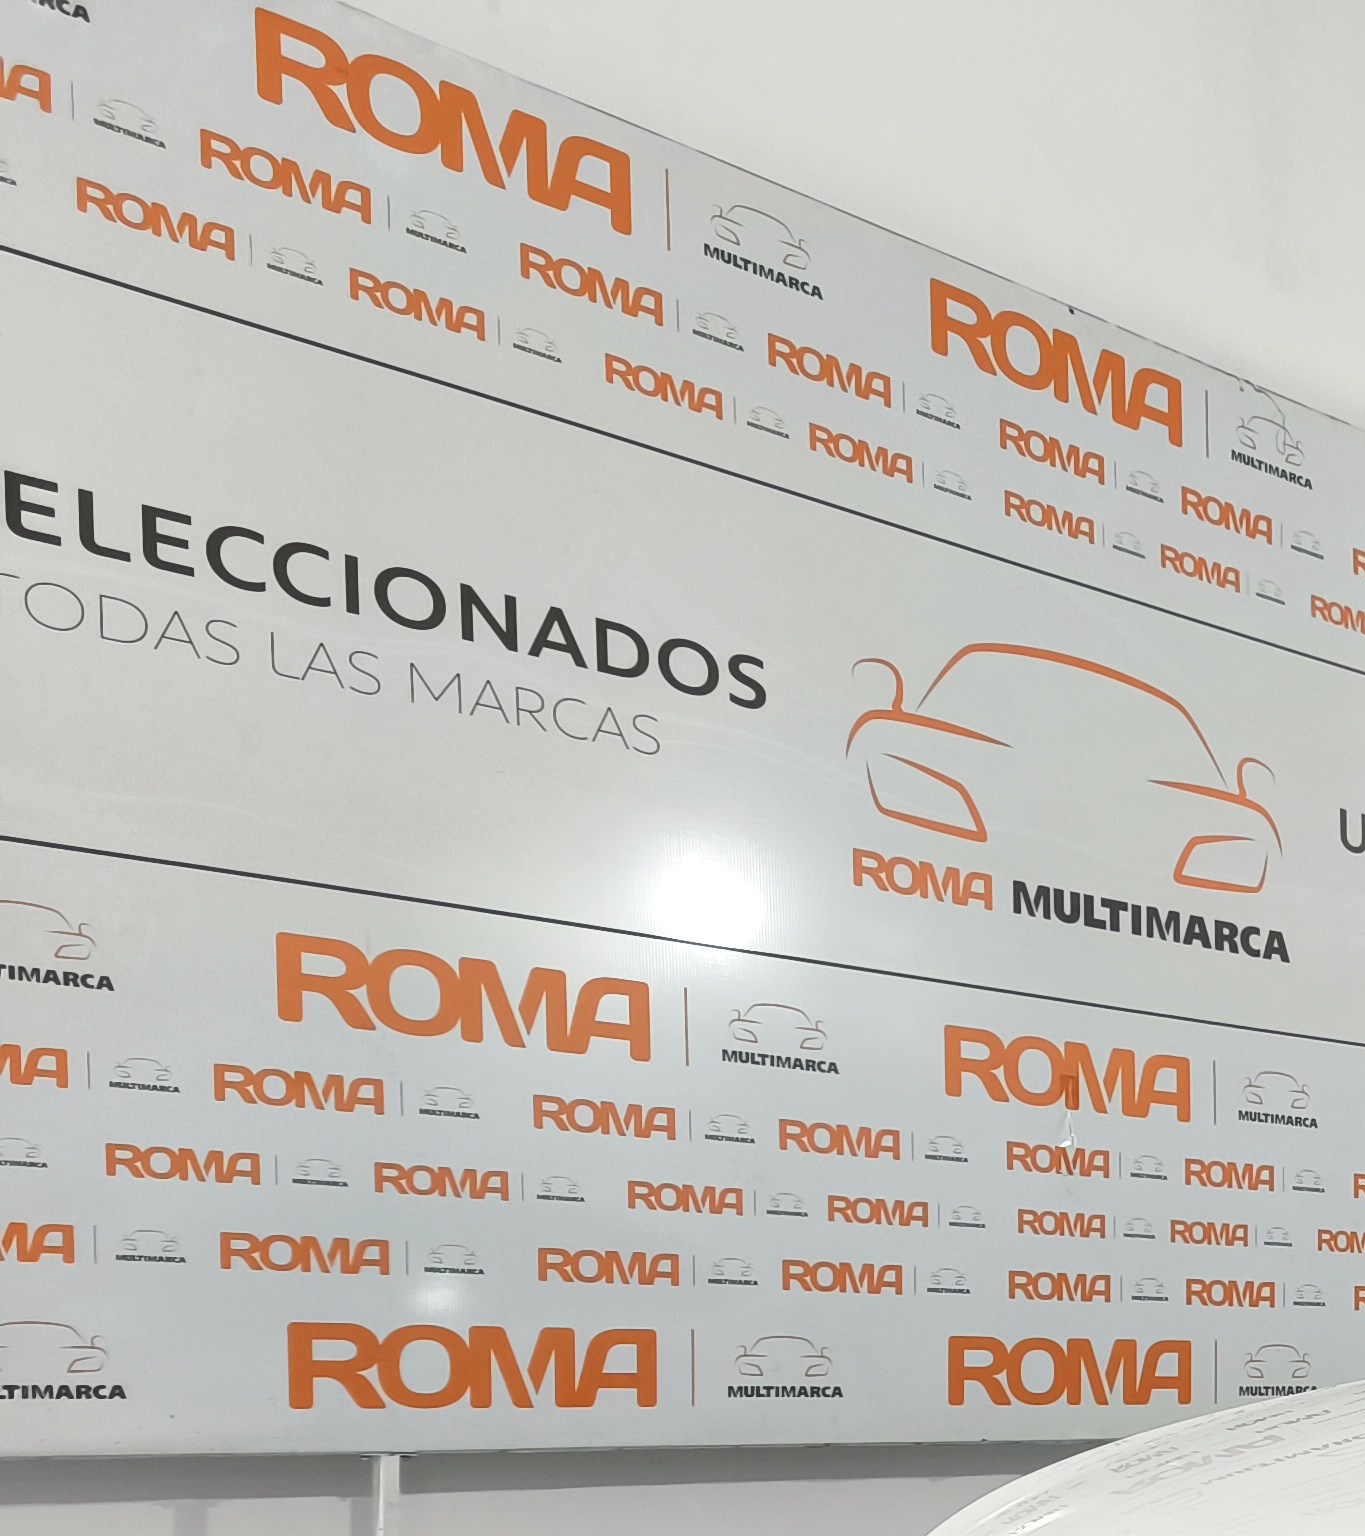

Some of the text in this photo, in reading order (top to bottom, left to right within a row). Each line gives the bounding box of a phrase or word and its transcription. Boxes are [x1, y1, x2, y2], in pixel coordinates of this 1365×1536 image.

[256, 7, 632, 236] ROMA
[200, 129, 372, 224] ROMA
[76, 178, 235, 261] ROMA
[520, 244, 664, 327] ROMA
[703, 242, 823, 301] MULTIMARCA
[350, 269, 486, 341] ROMA
[606, 355, 723, 420] ROMA
[768, 334, 892, 408] ROMA
[930, 279, 1182, 447] ROMA
[810, 424, 912, 483] ROMA
[1000, 420, 1104, 484] ROMA
[1230, 448, 1313, 491] MULTIMARCA
[1005, 492, 1094, 544] ROMA
[1182, 488, 1272, 544] ROMA
[3, 470, 768, 710] ELECCIONADOS
[1161, 546, 1240, 592] ROMA
[269, 631, 382, 695] LAS
[409, 661, 662, 755] MARCAS
[854, 849, 1291, 965] ROMA MULTIMARCA
[276, 932, 651, 1062] ROMA
[721, 1048, 840, 1075] MULTIMARCA
[944, 1026, 1191, 1123] ROMA
[214, 1065, 384, 1115] ROMA
[534, 1096, 676, 1140] ROMA
[780, 1120, 900, 1160] ROMA
[1237, 1109, 1319, 1130] MULTIMARCA
[106, 1144, 260, 1185] ROMA
[375, 1163, 509, 1200] ROMA
[1008, 1143, 1110, 1178] ROMA
[1186, 1160, 1274, 1192] ROMA
[628, 1182, 743, 1216] ROMA
[828, 1197, 928, 1227] ROMA
[1018, 1211, 1106, 1238] ROMA
[1172, 1221, 1248, 1247] ROMA
[220, 1233, 390, 1276] ROMA
[538, 1249, 680, 1286] ROMA
[783, 1261, 902, 1295] ROMA
[1010, 1272, 1111, 1303] ROMA
[1187, 1280, 1276, 1308] ROMA
[288, 1323, 658, 1410] ROMA
[949, 1336, 1192, 1407] ROMA
[727, 1385, 844, 1399] MULTIMARCA
